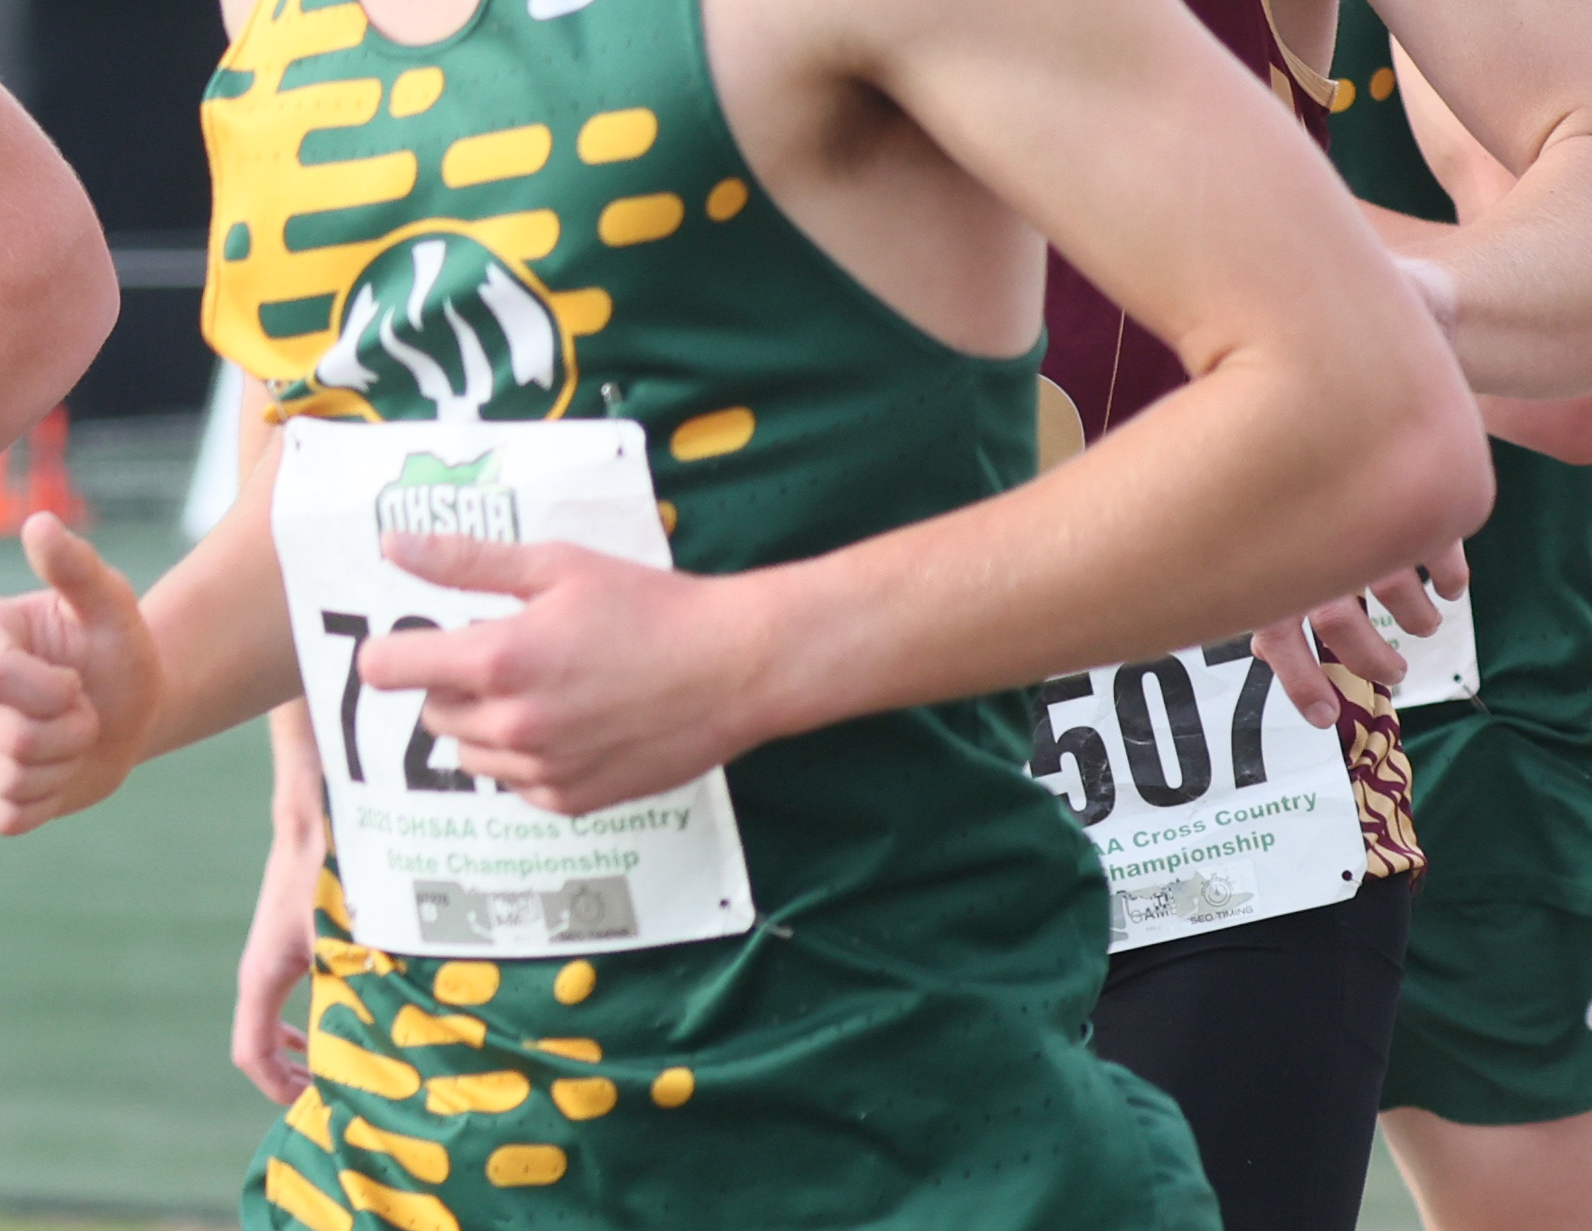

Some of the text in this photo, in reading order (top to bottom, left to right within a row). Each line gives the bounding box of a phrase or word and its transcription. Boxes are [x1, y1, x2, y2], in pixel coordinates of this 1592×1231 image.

[379, 484, 515, 542] OHSAA
[486, 819, 559, 839] Cross
[572, 808, 690, 835] Country
[1133, 820, 1206, 848] Cross
[1215, 792, 1316, 826] Country
[446, 849, 640, 878] Championship
[1110, 831, 1275, 881] hampionship
[1190, 905, 1253, 924] SEO TIMING
